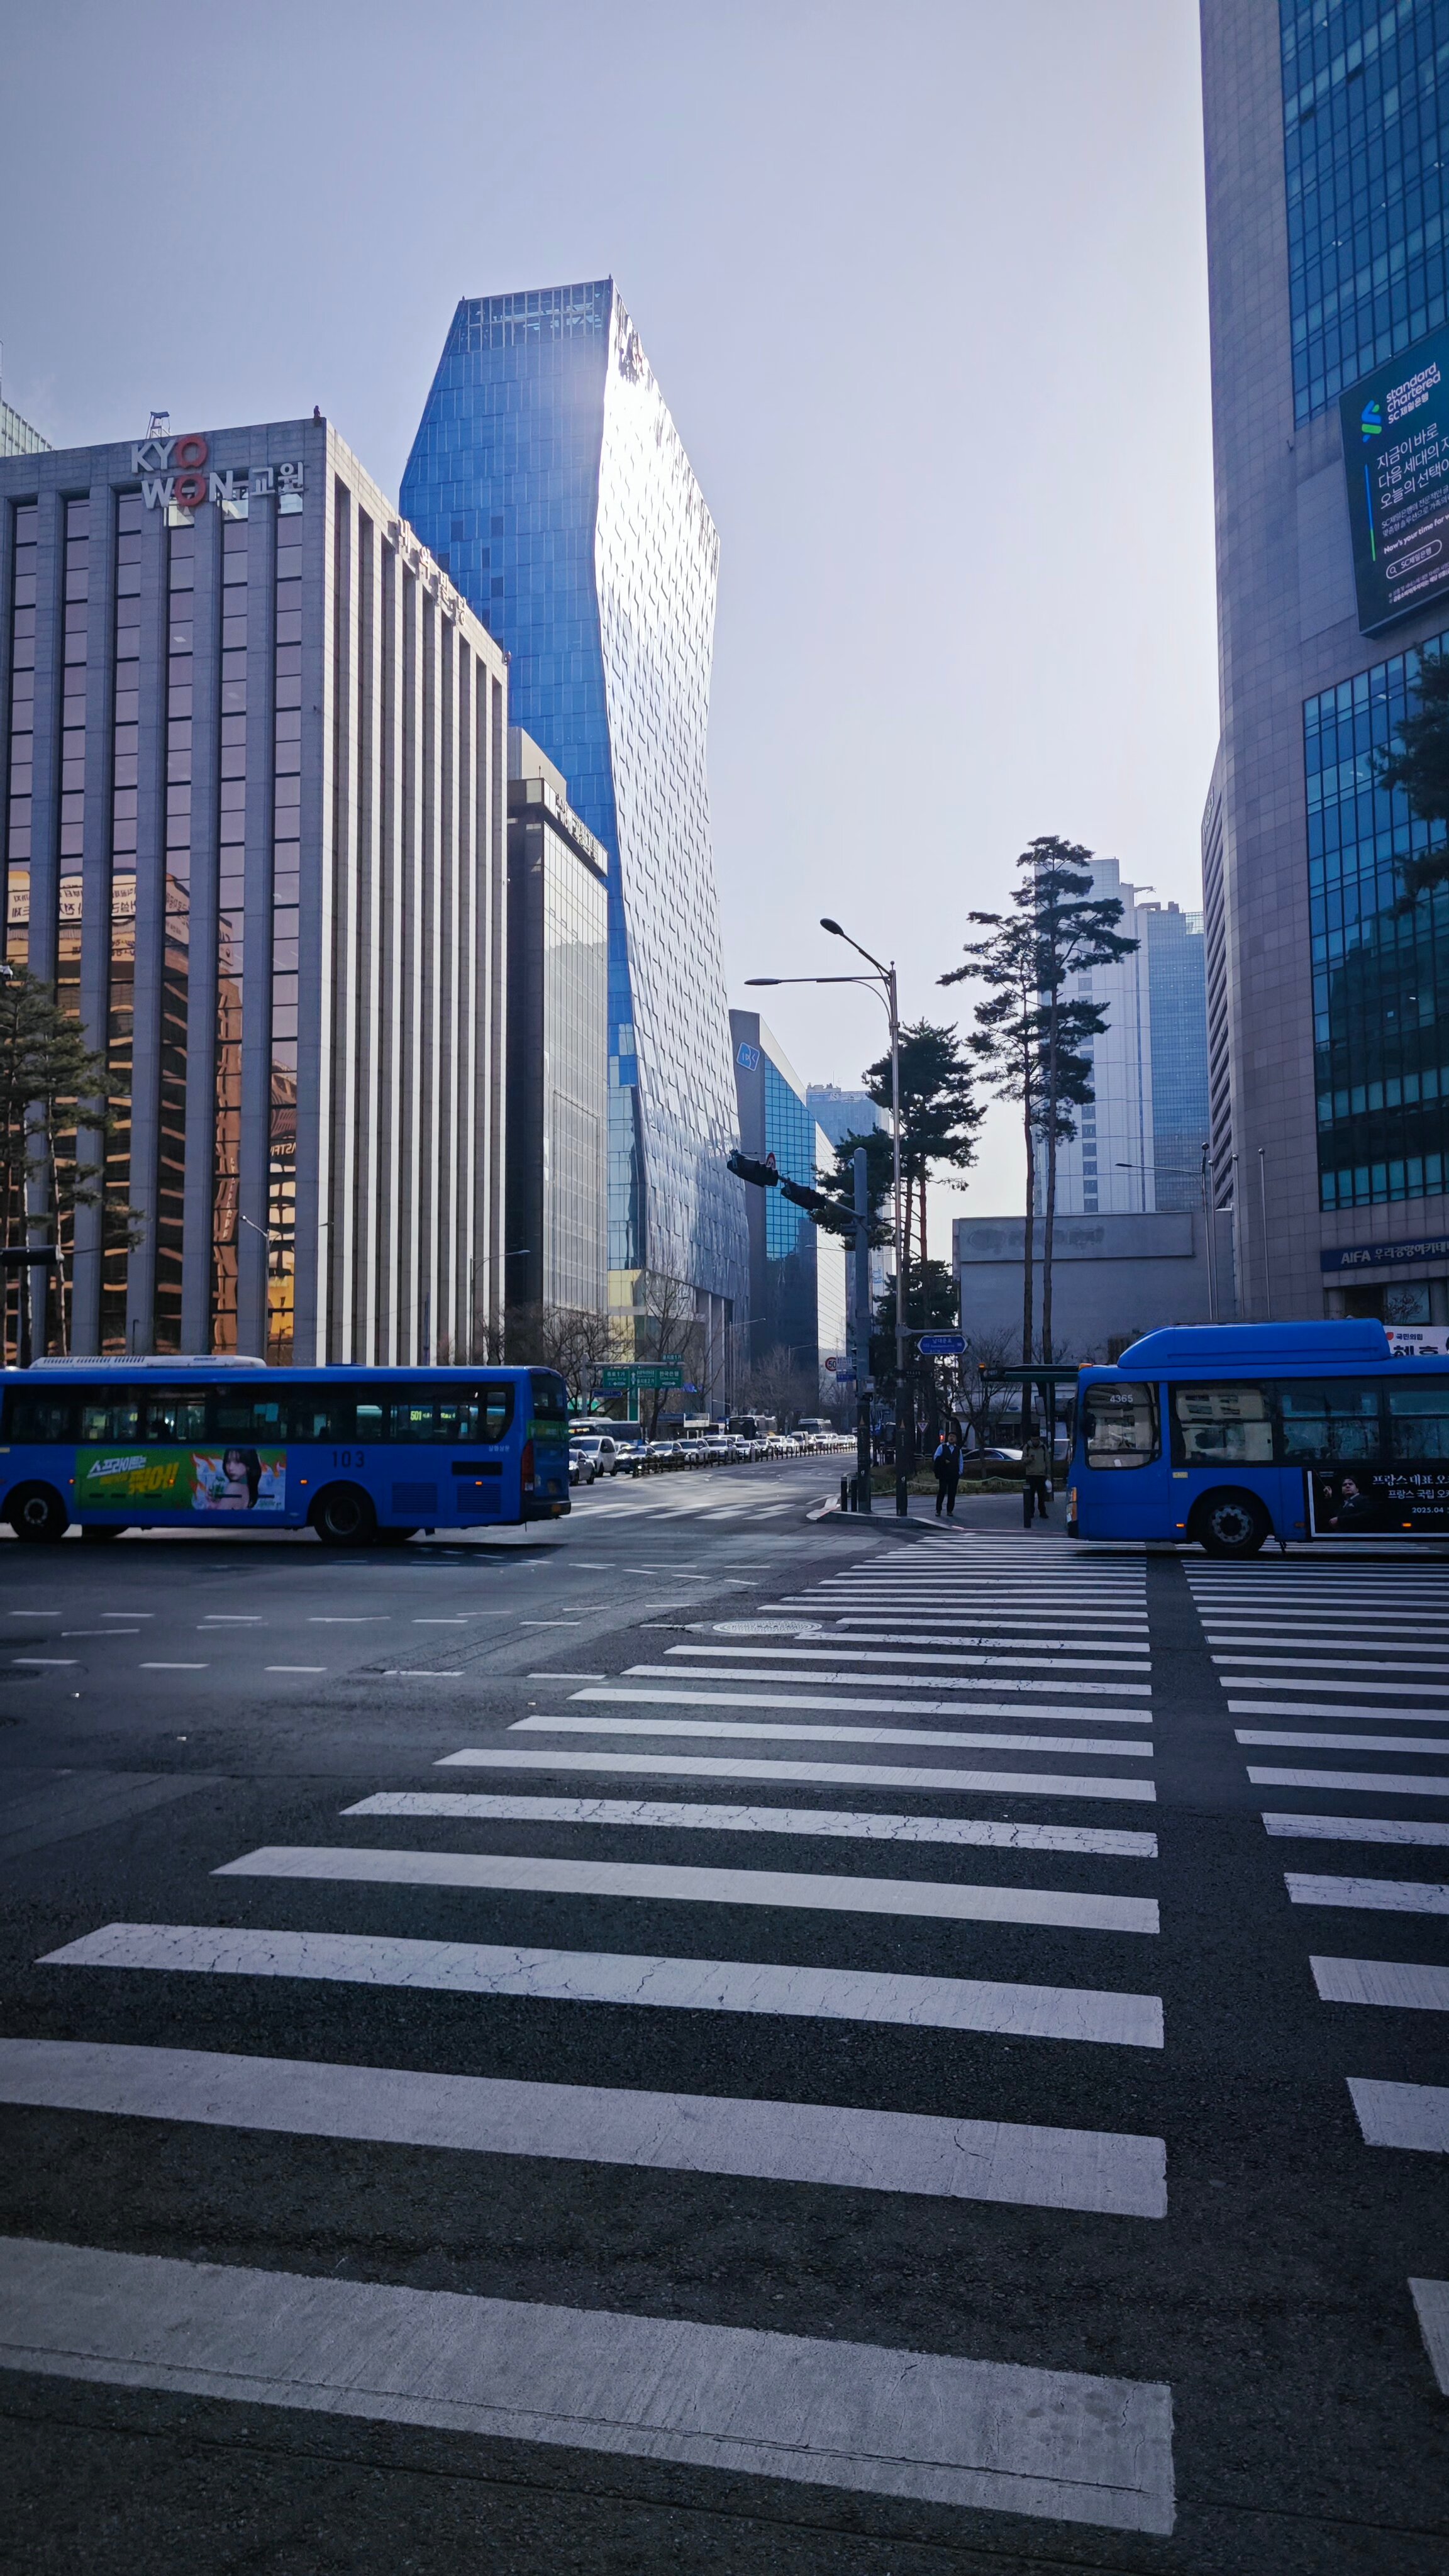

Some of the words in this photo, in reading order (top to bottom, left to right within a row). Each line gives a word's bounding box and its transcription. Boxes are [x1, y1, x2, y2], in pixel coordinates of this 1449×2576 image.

[1386, 362, 1436, 403] standard
[1387, 370, 1441, 413] chartered
[131, 435, 208, 474] KYO
[1377, 437, 1412, 469] 지금이
[1414, 422, 1439, 447] 바로
[1379, 465, 1402, 488] 다음
[1404, 441, 1439, 474] 세대의
[141, 470, 234, 509] WON
[249, 462, 304, 496] 교원
[1380, 477, 1415, 509] 오늘의
[1419, 488, 1442, 508] 전문적인
[1430, 494, 1447, 511] 가족의
[1384, 540, 1403, 554] Now's
[1404, 531, 1418, 546] your
[1418, 523, 1433, 535] time
[1434, 516, 1444, 526] for
[1401, 547, 1431, 569] SC제일은행
[1341, 1250, 1371, 1265] AIFA
[1110, 1394, 1133, 1402] 4365
[86, 1455, 147, 1479] 스프라이트는
[332, 1450, 364, 1468] 103
[1372, 1474, 1408, 1486] 프랑스
[1409, 1474, 1433, 1486] 대표
[1388, 1490, 1414, 1499] 프랑스
[1416, 1489, 1435, 1499] 국립
